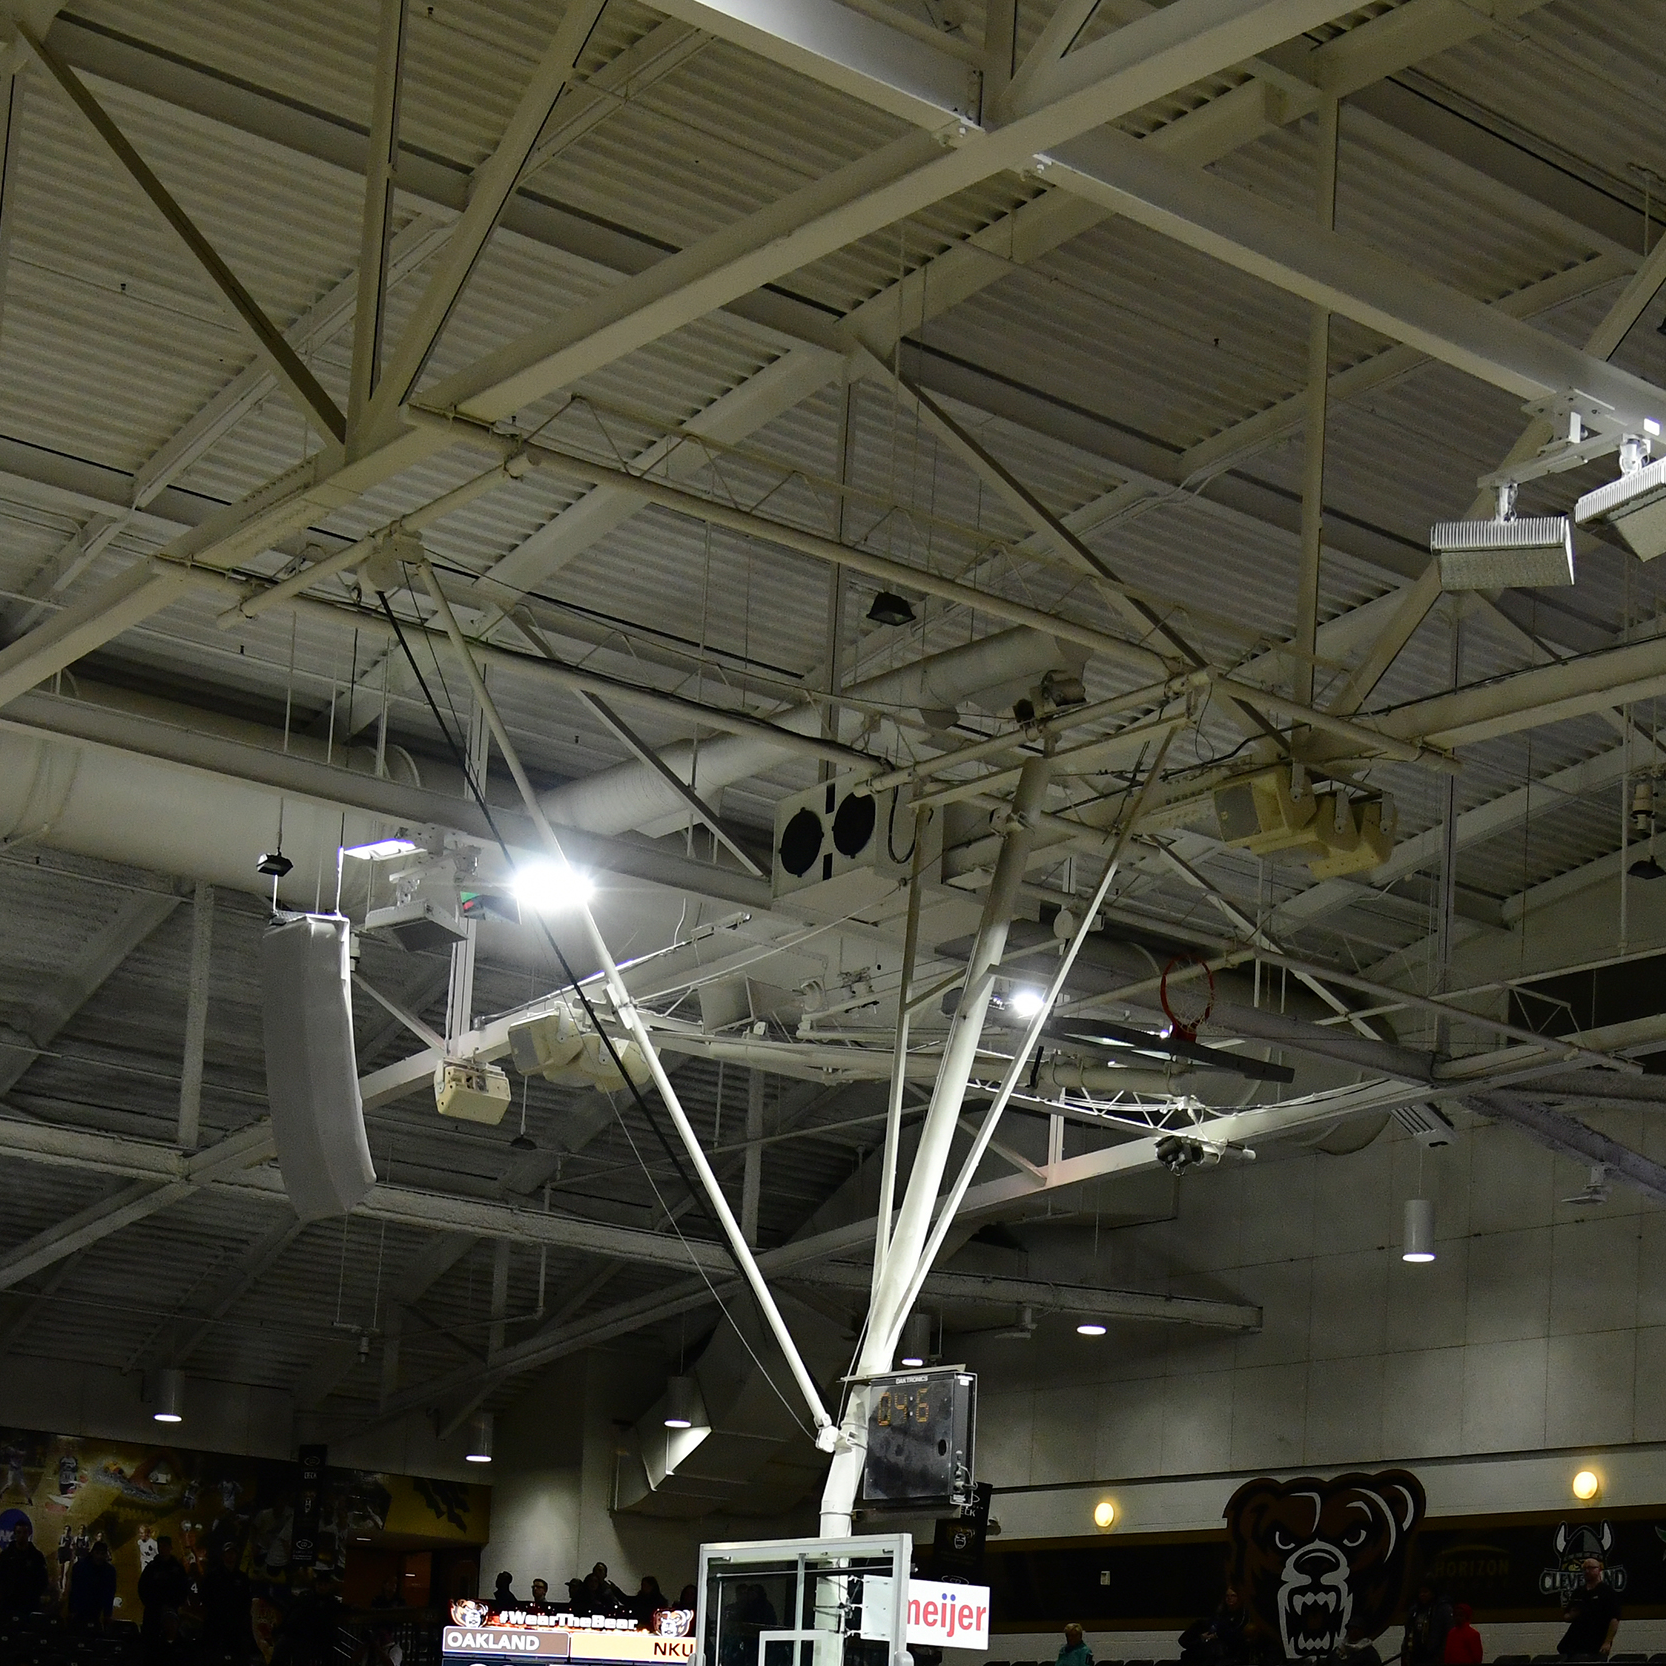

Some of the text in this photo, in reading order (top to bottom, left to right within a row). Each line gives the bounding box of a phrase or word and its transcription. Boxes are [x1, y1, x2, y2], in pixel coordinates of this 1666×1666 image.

[1434, 1557, 1510, 1578] HORIZON
[1539, 1567, 1627, 1594] CLEVEND
[499, 1611, 638, 1631] #WearTheBear
[447, 1632, 540, 1651] OAKLAND
[654, 1643, 694, 1657] NKU
